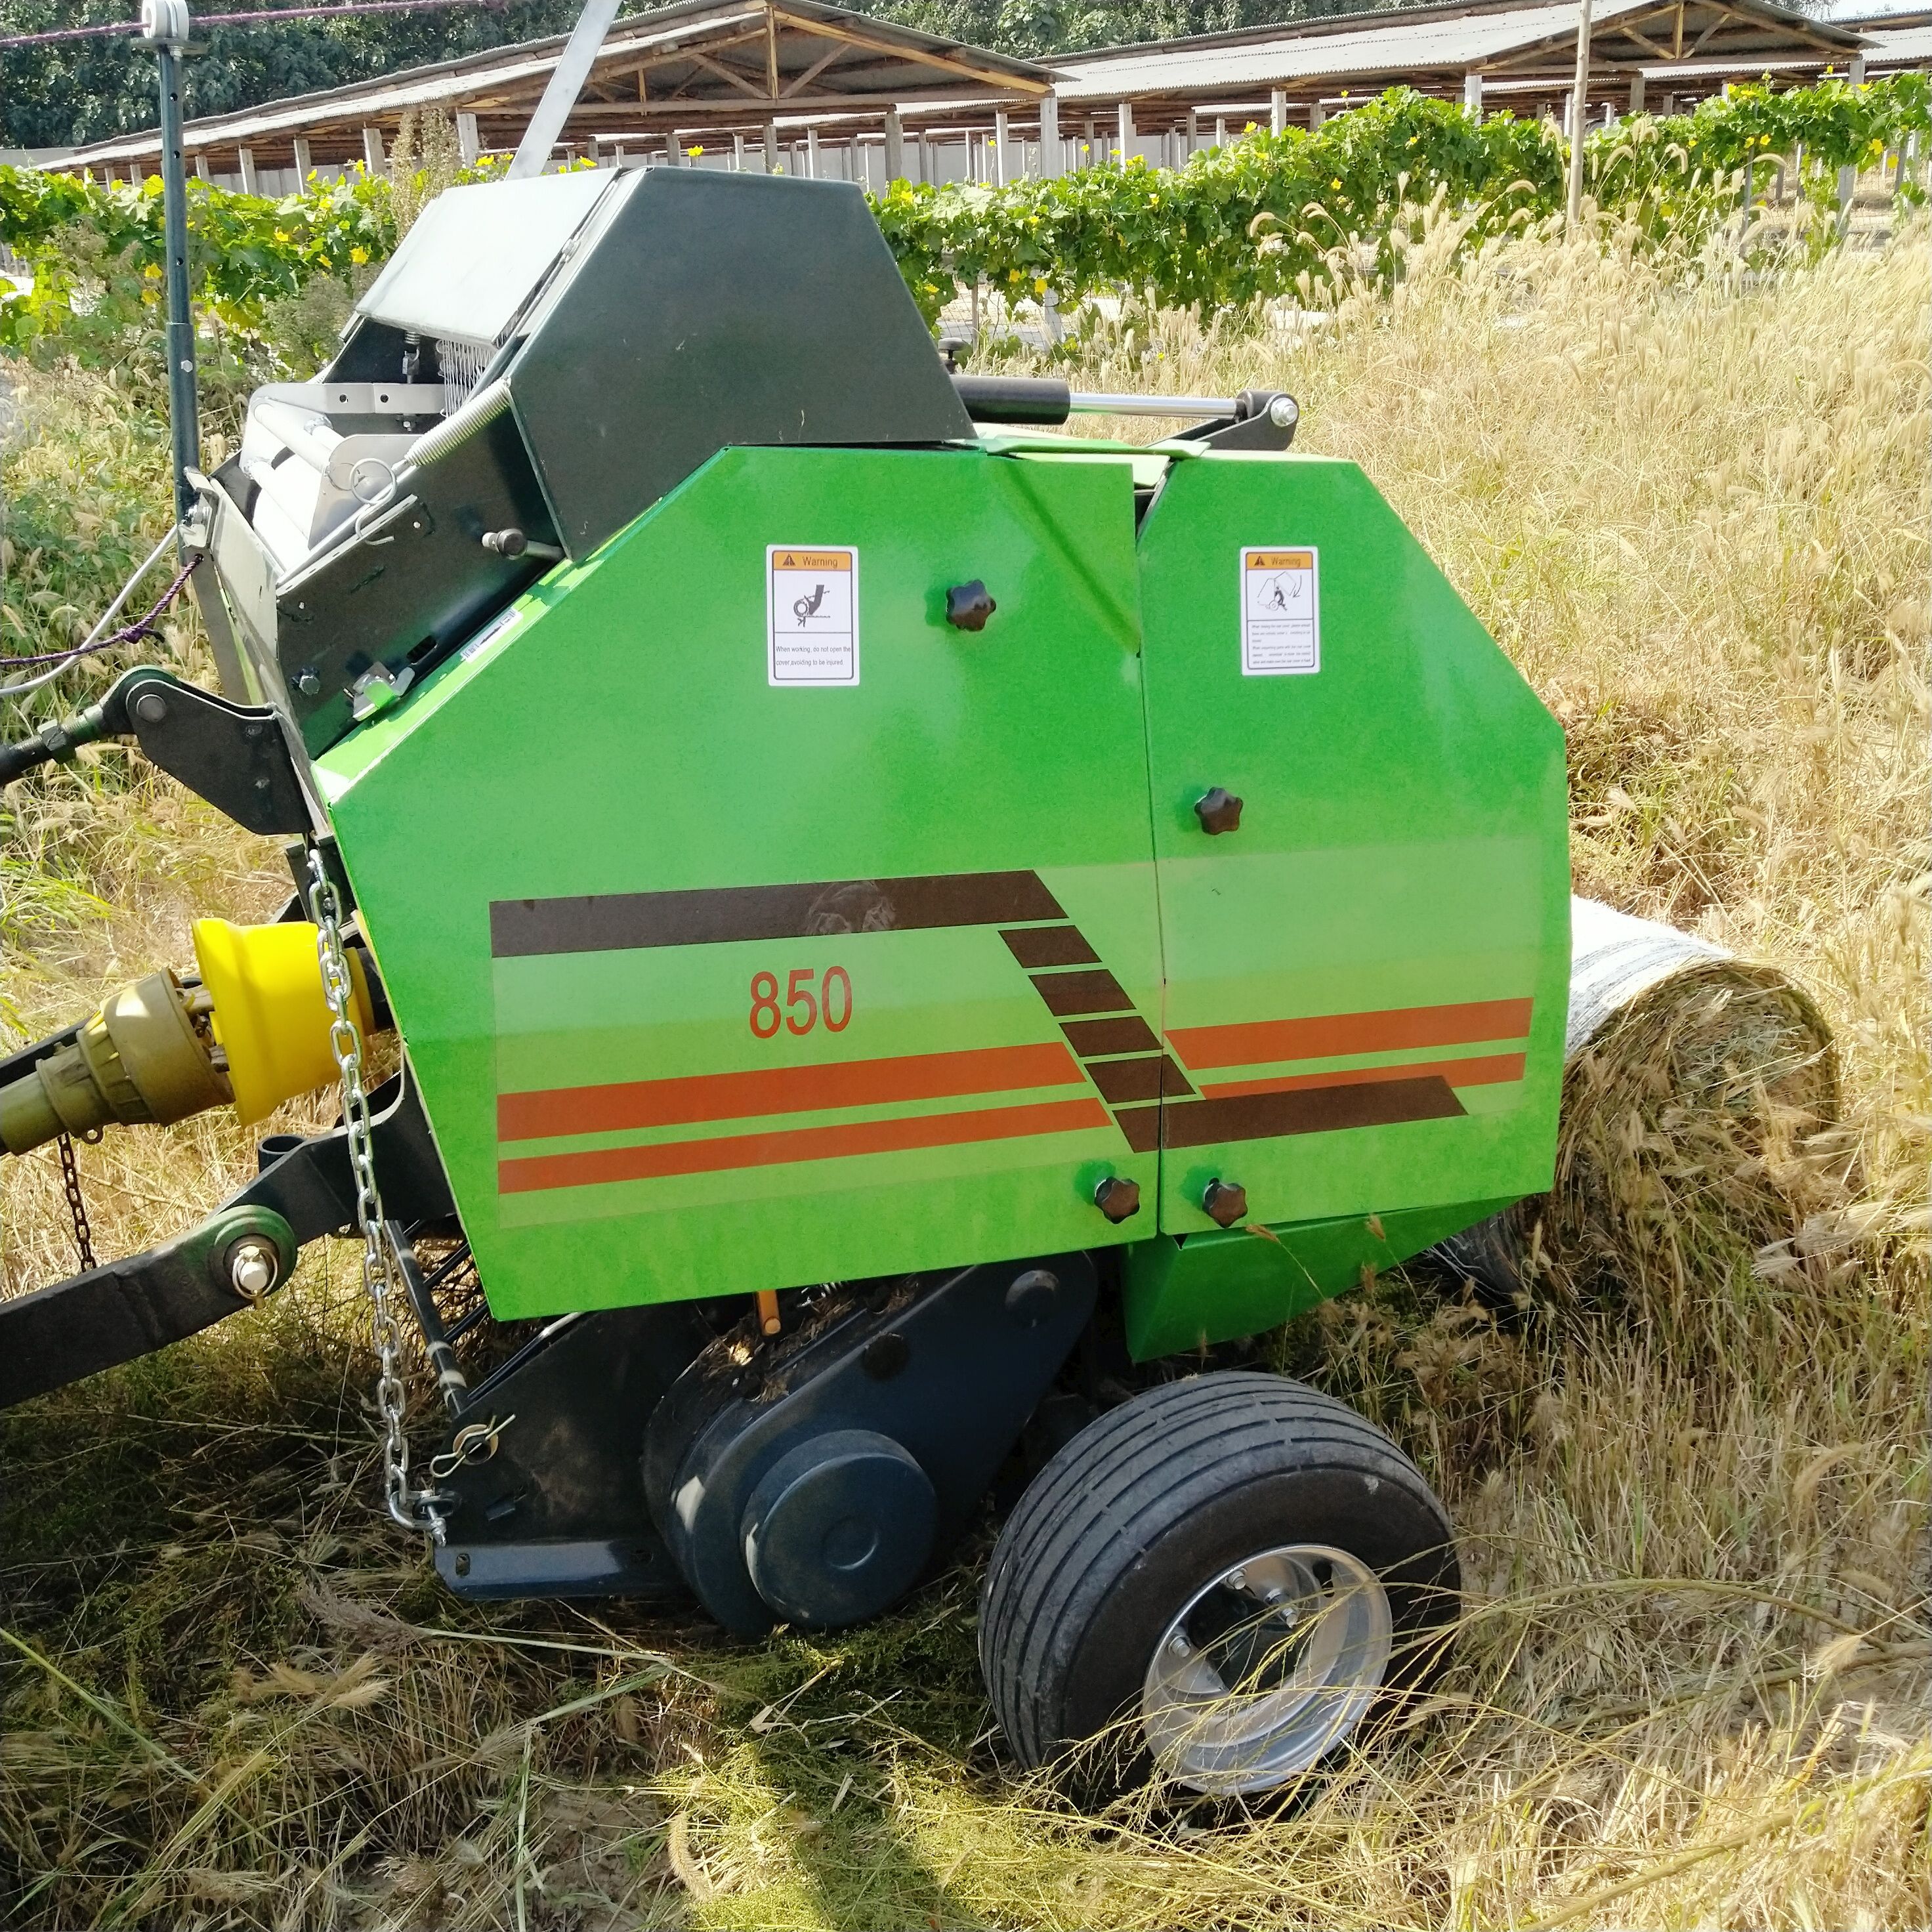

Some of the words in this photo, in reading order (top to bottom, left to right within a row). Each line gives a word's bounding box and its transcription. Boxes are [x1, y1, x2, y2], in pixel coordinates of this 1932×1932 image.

[802, 556, 838, 569] Warning
[1270, 556, 1301, 568] Warning
[749, 965, 852, 1039] 850
